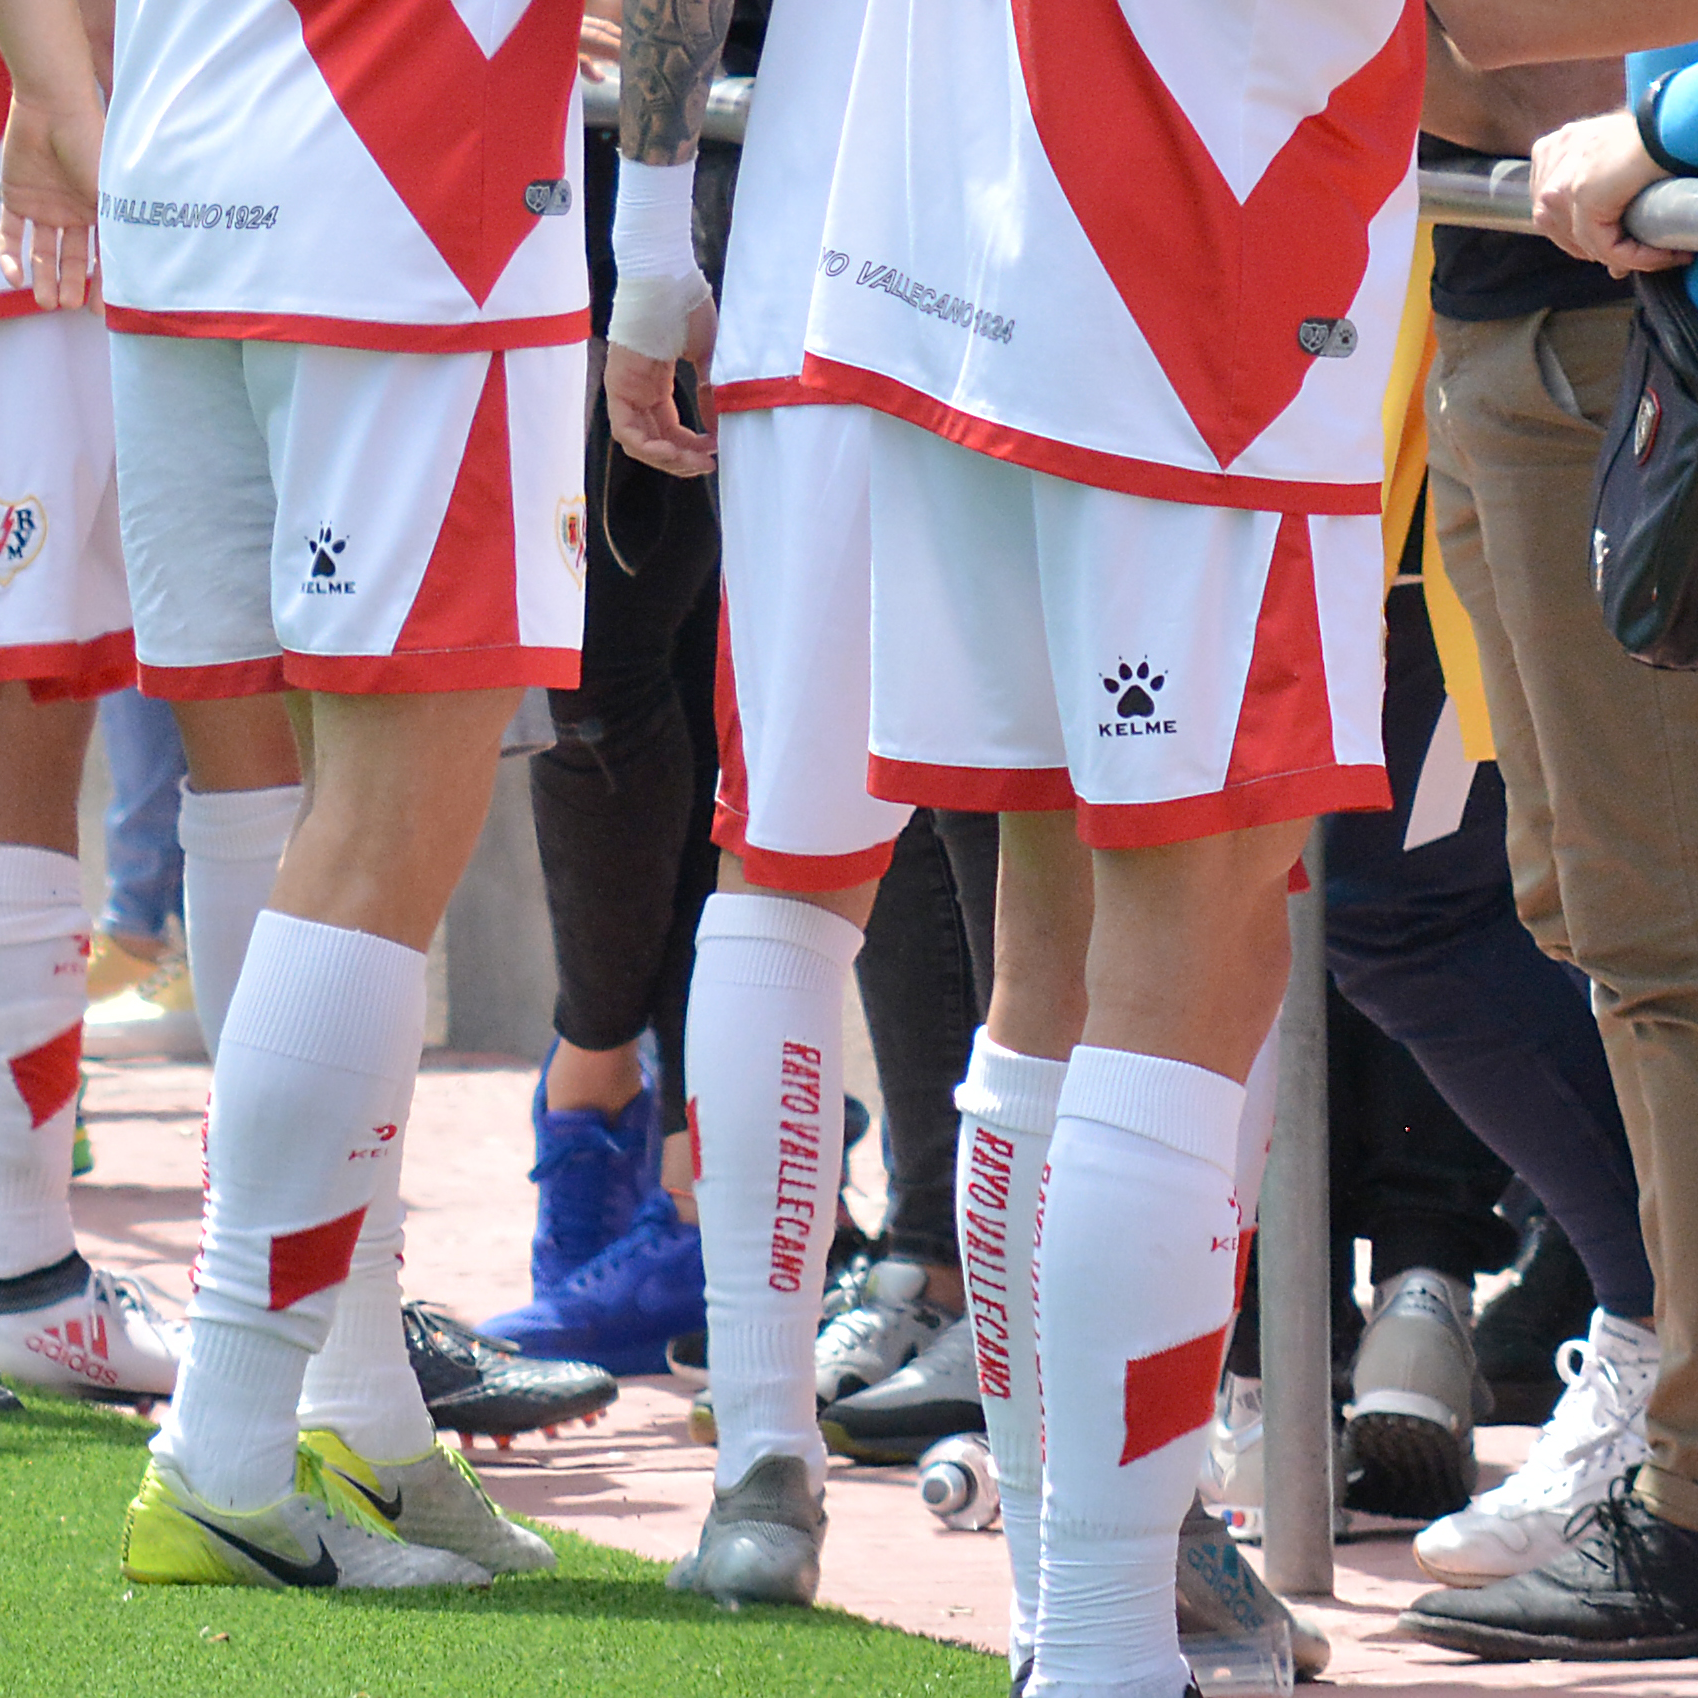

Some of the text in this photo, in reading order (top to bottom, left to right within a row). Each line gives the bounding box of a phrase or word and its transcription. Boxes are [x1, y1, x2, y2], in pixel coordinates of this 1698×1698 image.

[113, 196, 223, 229] VALLECANO
[226, 205, 279, 230] 1924
[856, 261, 975, 328] VALLECANO
[973, 309, 1015, 345] 1924
[301, 581, 356, 595] ELME
[1098, 720, 1177, 737] KELME
[768, 1041, 821, 1293] RAYO VALLECANO
[966, 1126, 1015, 1400] RAYO VALLECANO
[25, 1335, 119, 1386] adidas
